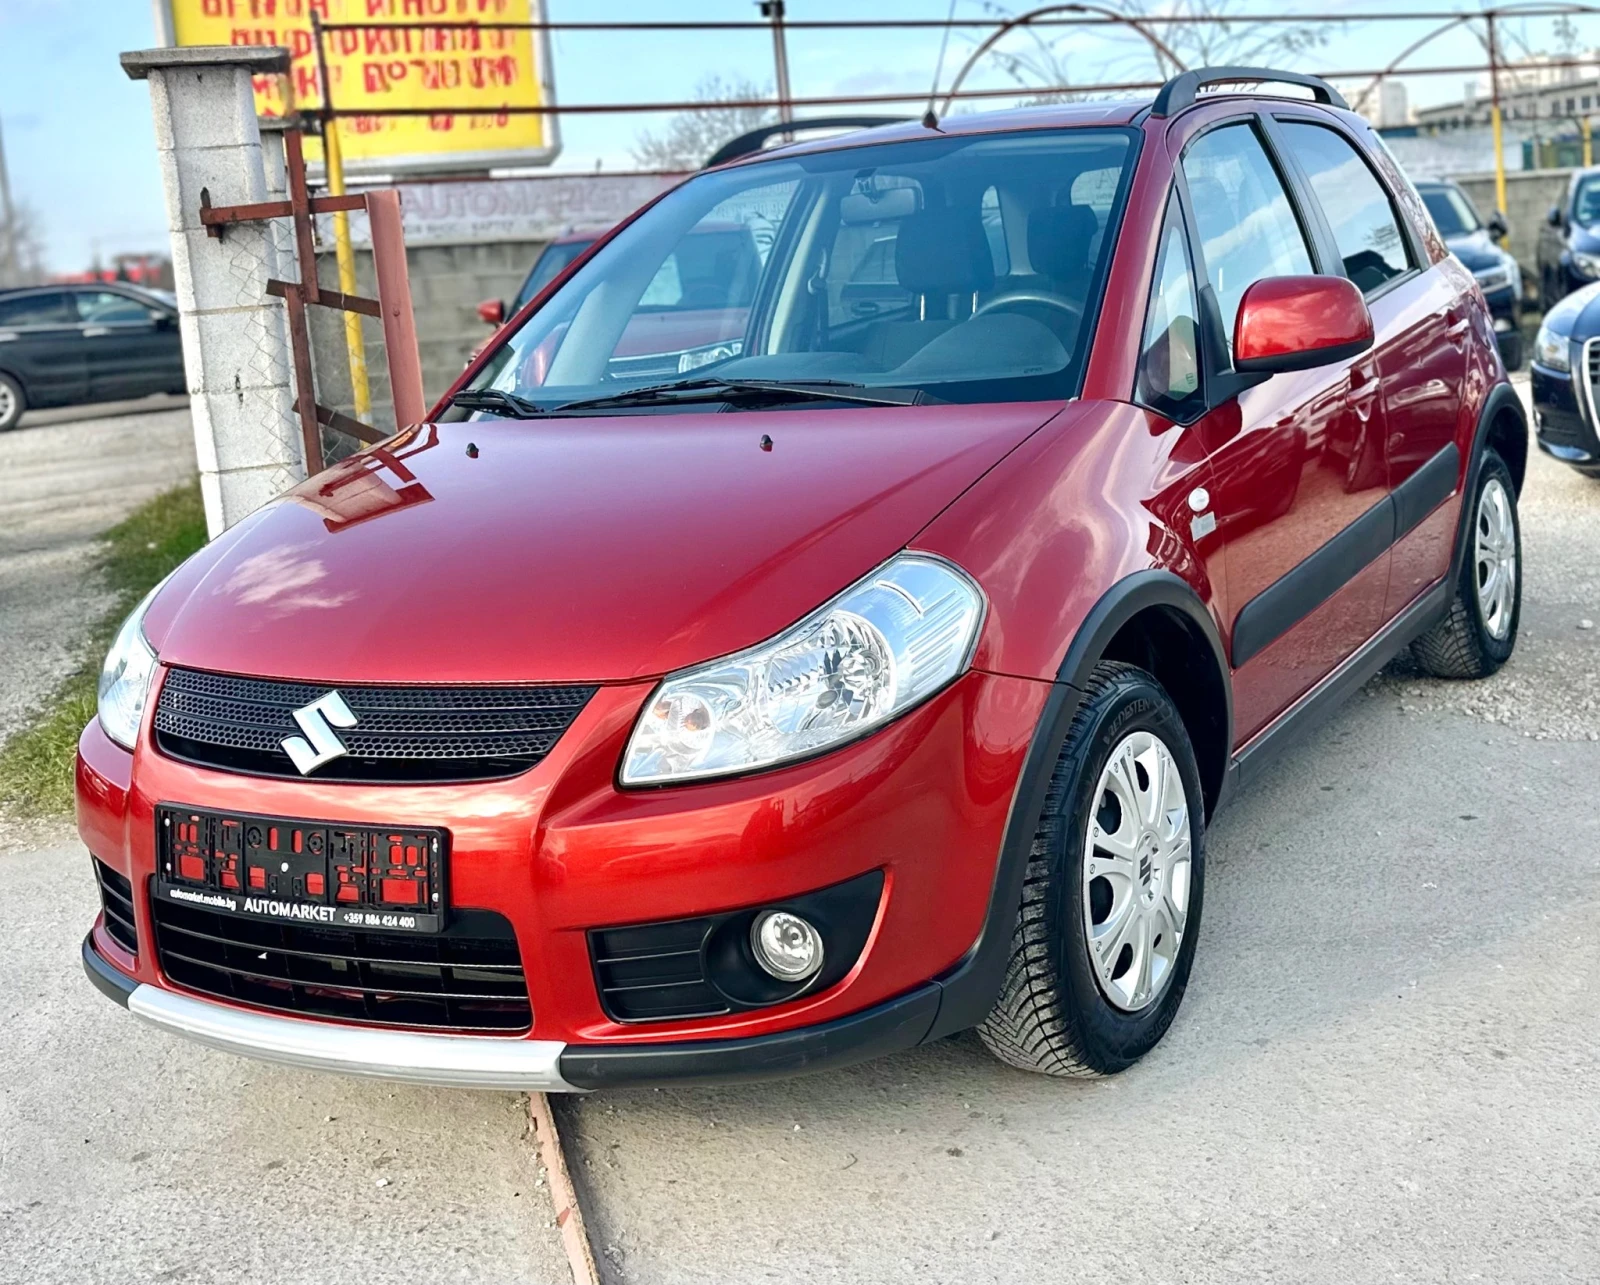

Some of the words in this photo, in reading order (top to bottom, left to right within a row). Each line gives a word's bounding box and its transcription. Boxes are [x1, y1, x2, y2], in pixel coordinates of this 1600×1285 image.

[170, 889, 237, 911] automarket.mobile.bg
[244, 897, 336, 922] AUTOMARKET
[343, 912, 364, 924] +359
[365, 913, 381, 926] 886
[382, 915, 398, 927] 424
[399, 916, 415, 928] 400
